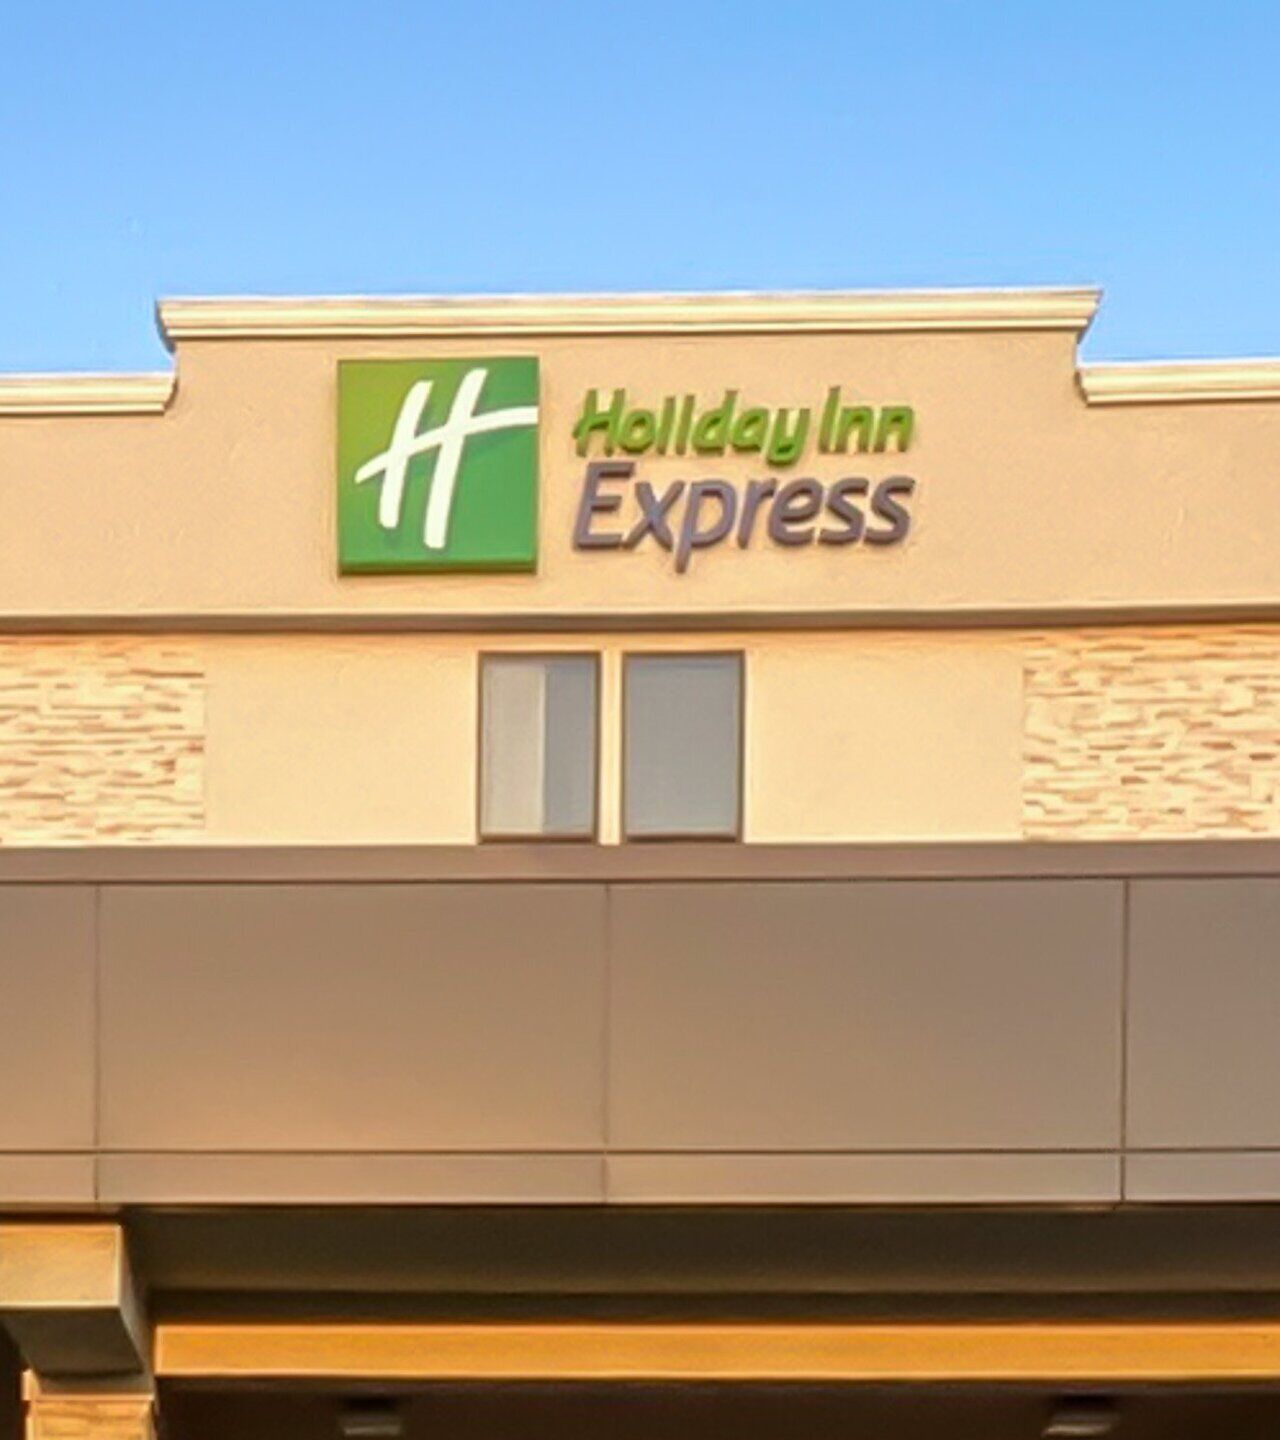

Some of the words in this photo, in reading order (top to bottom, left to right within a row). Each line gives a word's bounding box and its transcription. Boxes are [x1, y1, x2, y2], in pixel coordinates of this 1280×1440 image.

[572, 387, 810, 466] Holiday
[817, 385, 914, 454] Inn
[573, 461, 916, 575] Express
